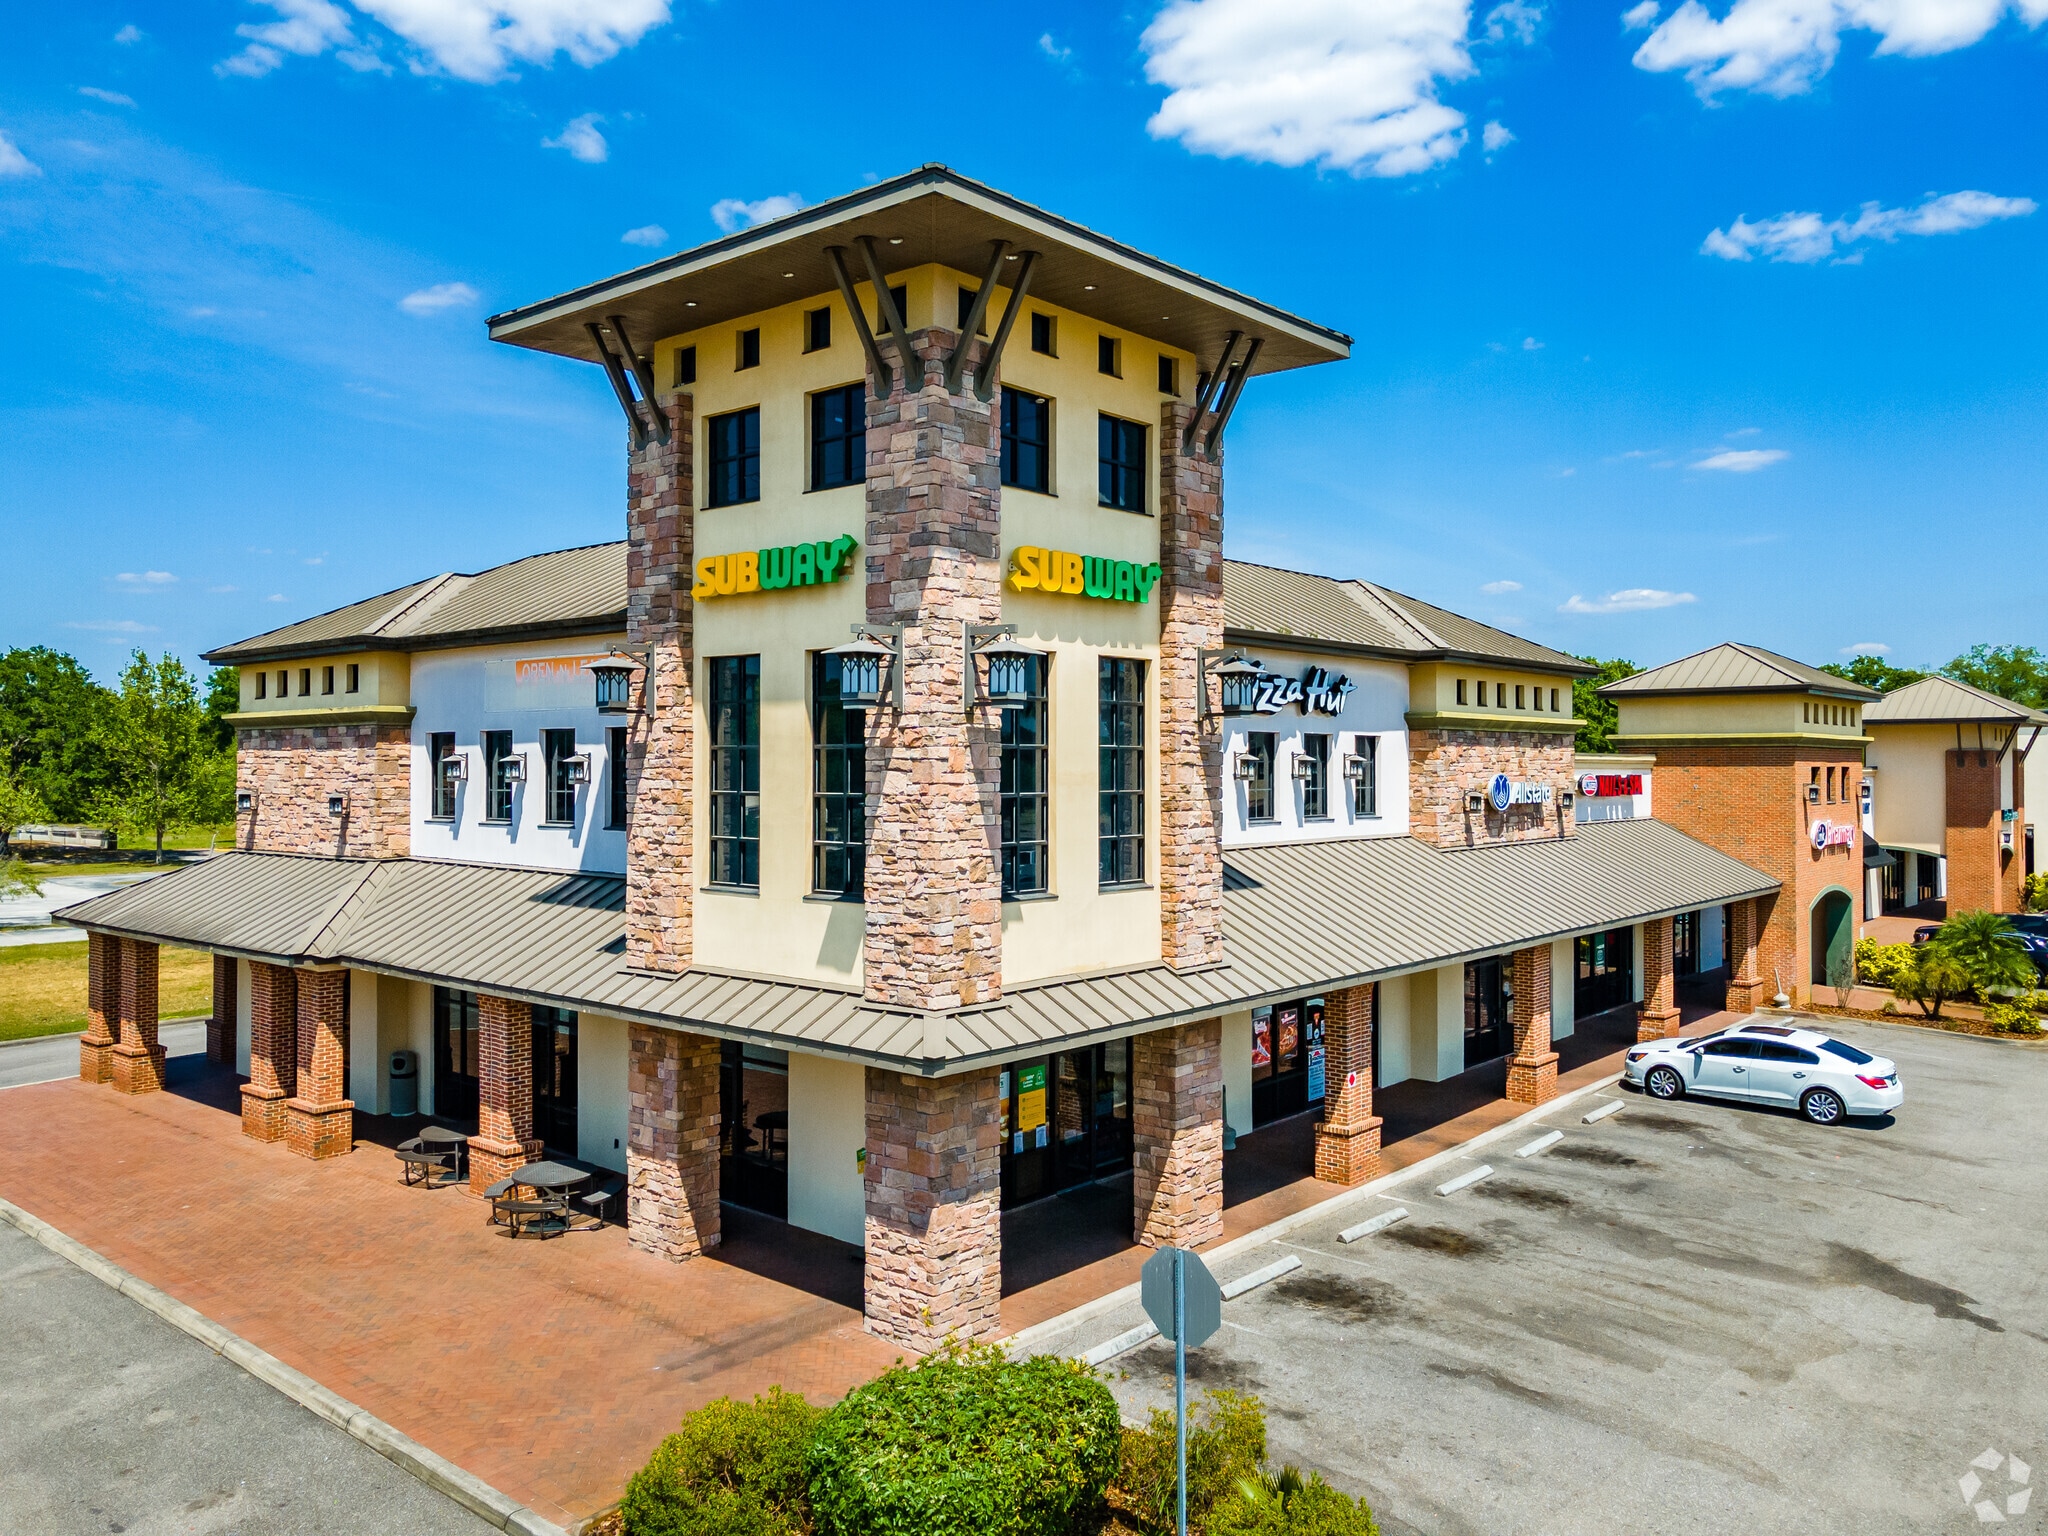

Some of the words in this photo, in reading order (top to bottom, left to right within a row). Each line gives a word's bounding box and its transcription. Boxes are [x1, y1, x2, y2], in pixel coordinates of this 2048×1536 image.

[691, 534, 858, 602] SUBWAY
[1008, 546, 1163, 604] SUBWAY
[1306, 669, 1358, 714] Hut
[1510, 782, 1552, 803] Allstate
